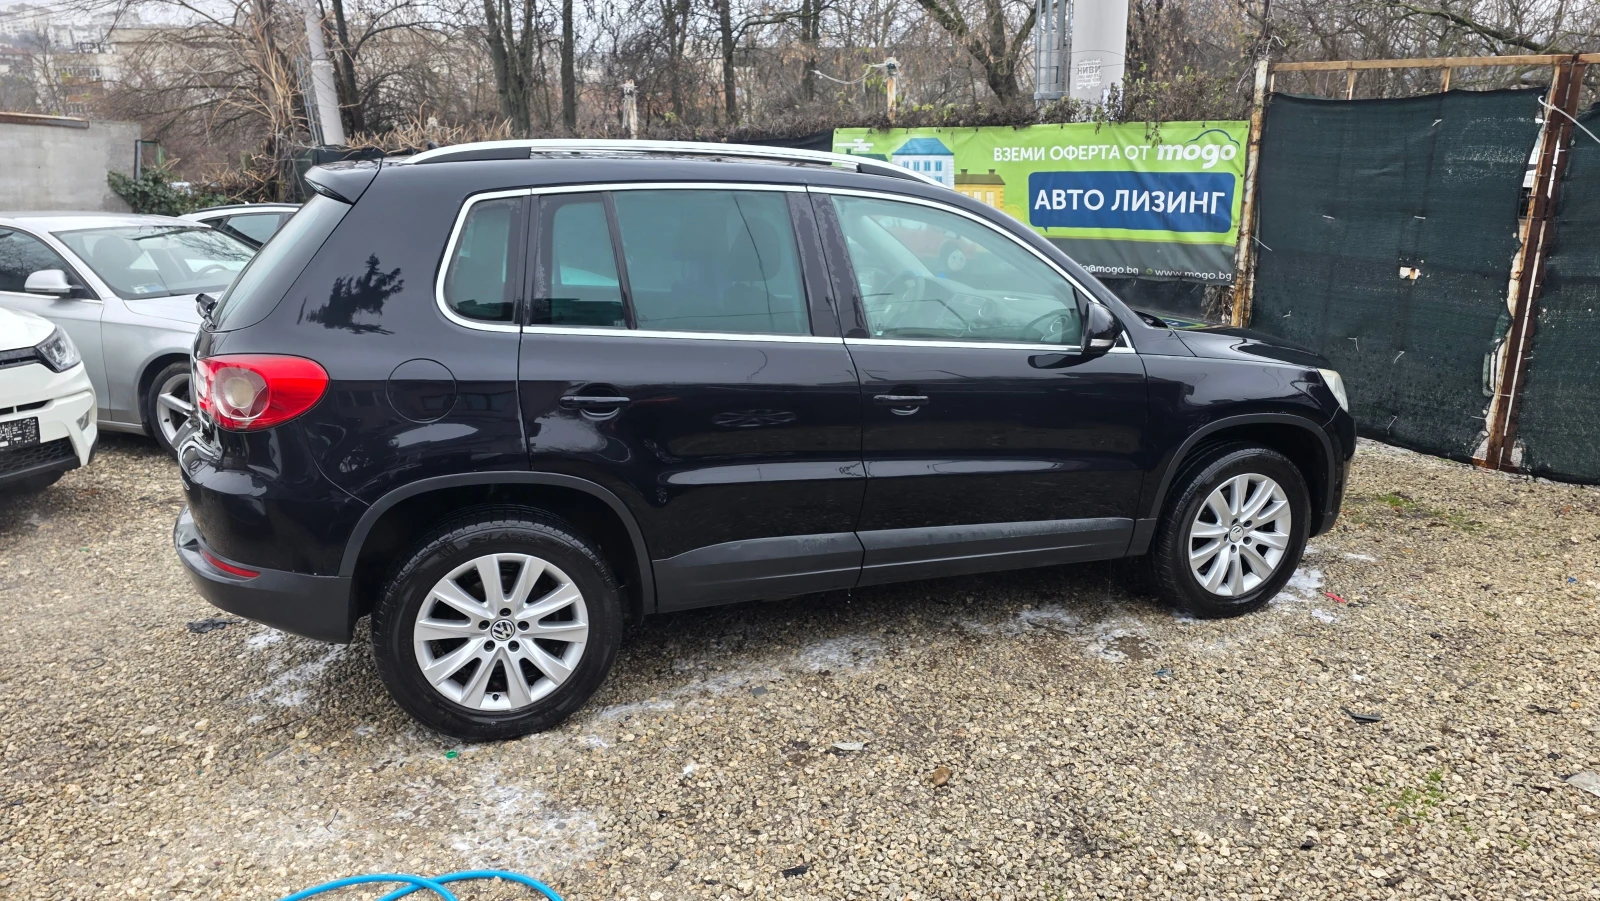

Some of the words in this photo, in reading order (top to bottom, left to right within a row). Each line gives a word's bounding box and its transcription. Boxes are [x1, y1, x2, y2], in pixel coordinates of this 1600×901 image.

[993, 147, 1045, 162] ВЗЕМИ
[1049, 145, 1121, 161] ОФЕРТА
[1124, 145, 1151, 161] ОТ
[1157, 143, 1237, 170] mogo
[1034, 189, 1105, 211] АВТО
[1111, 189, 1226, 215] ЛИЗИНГ
[1155, 269, 1232, 282] www.mogo.bg
